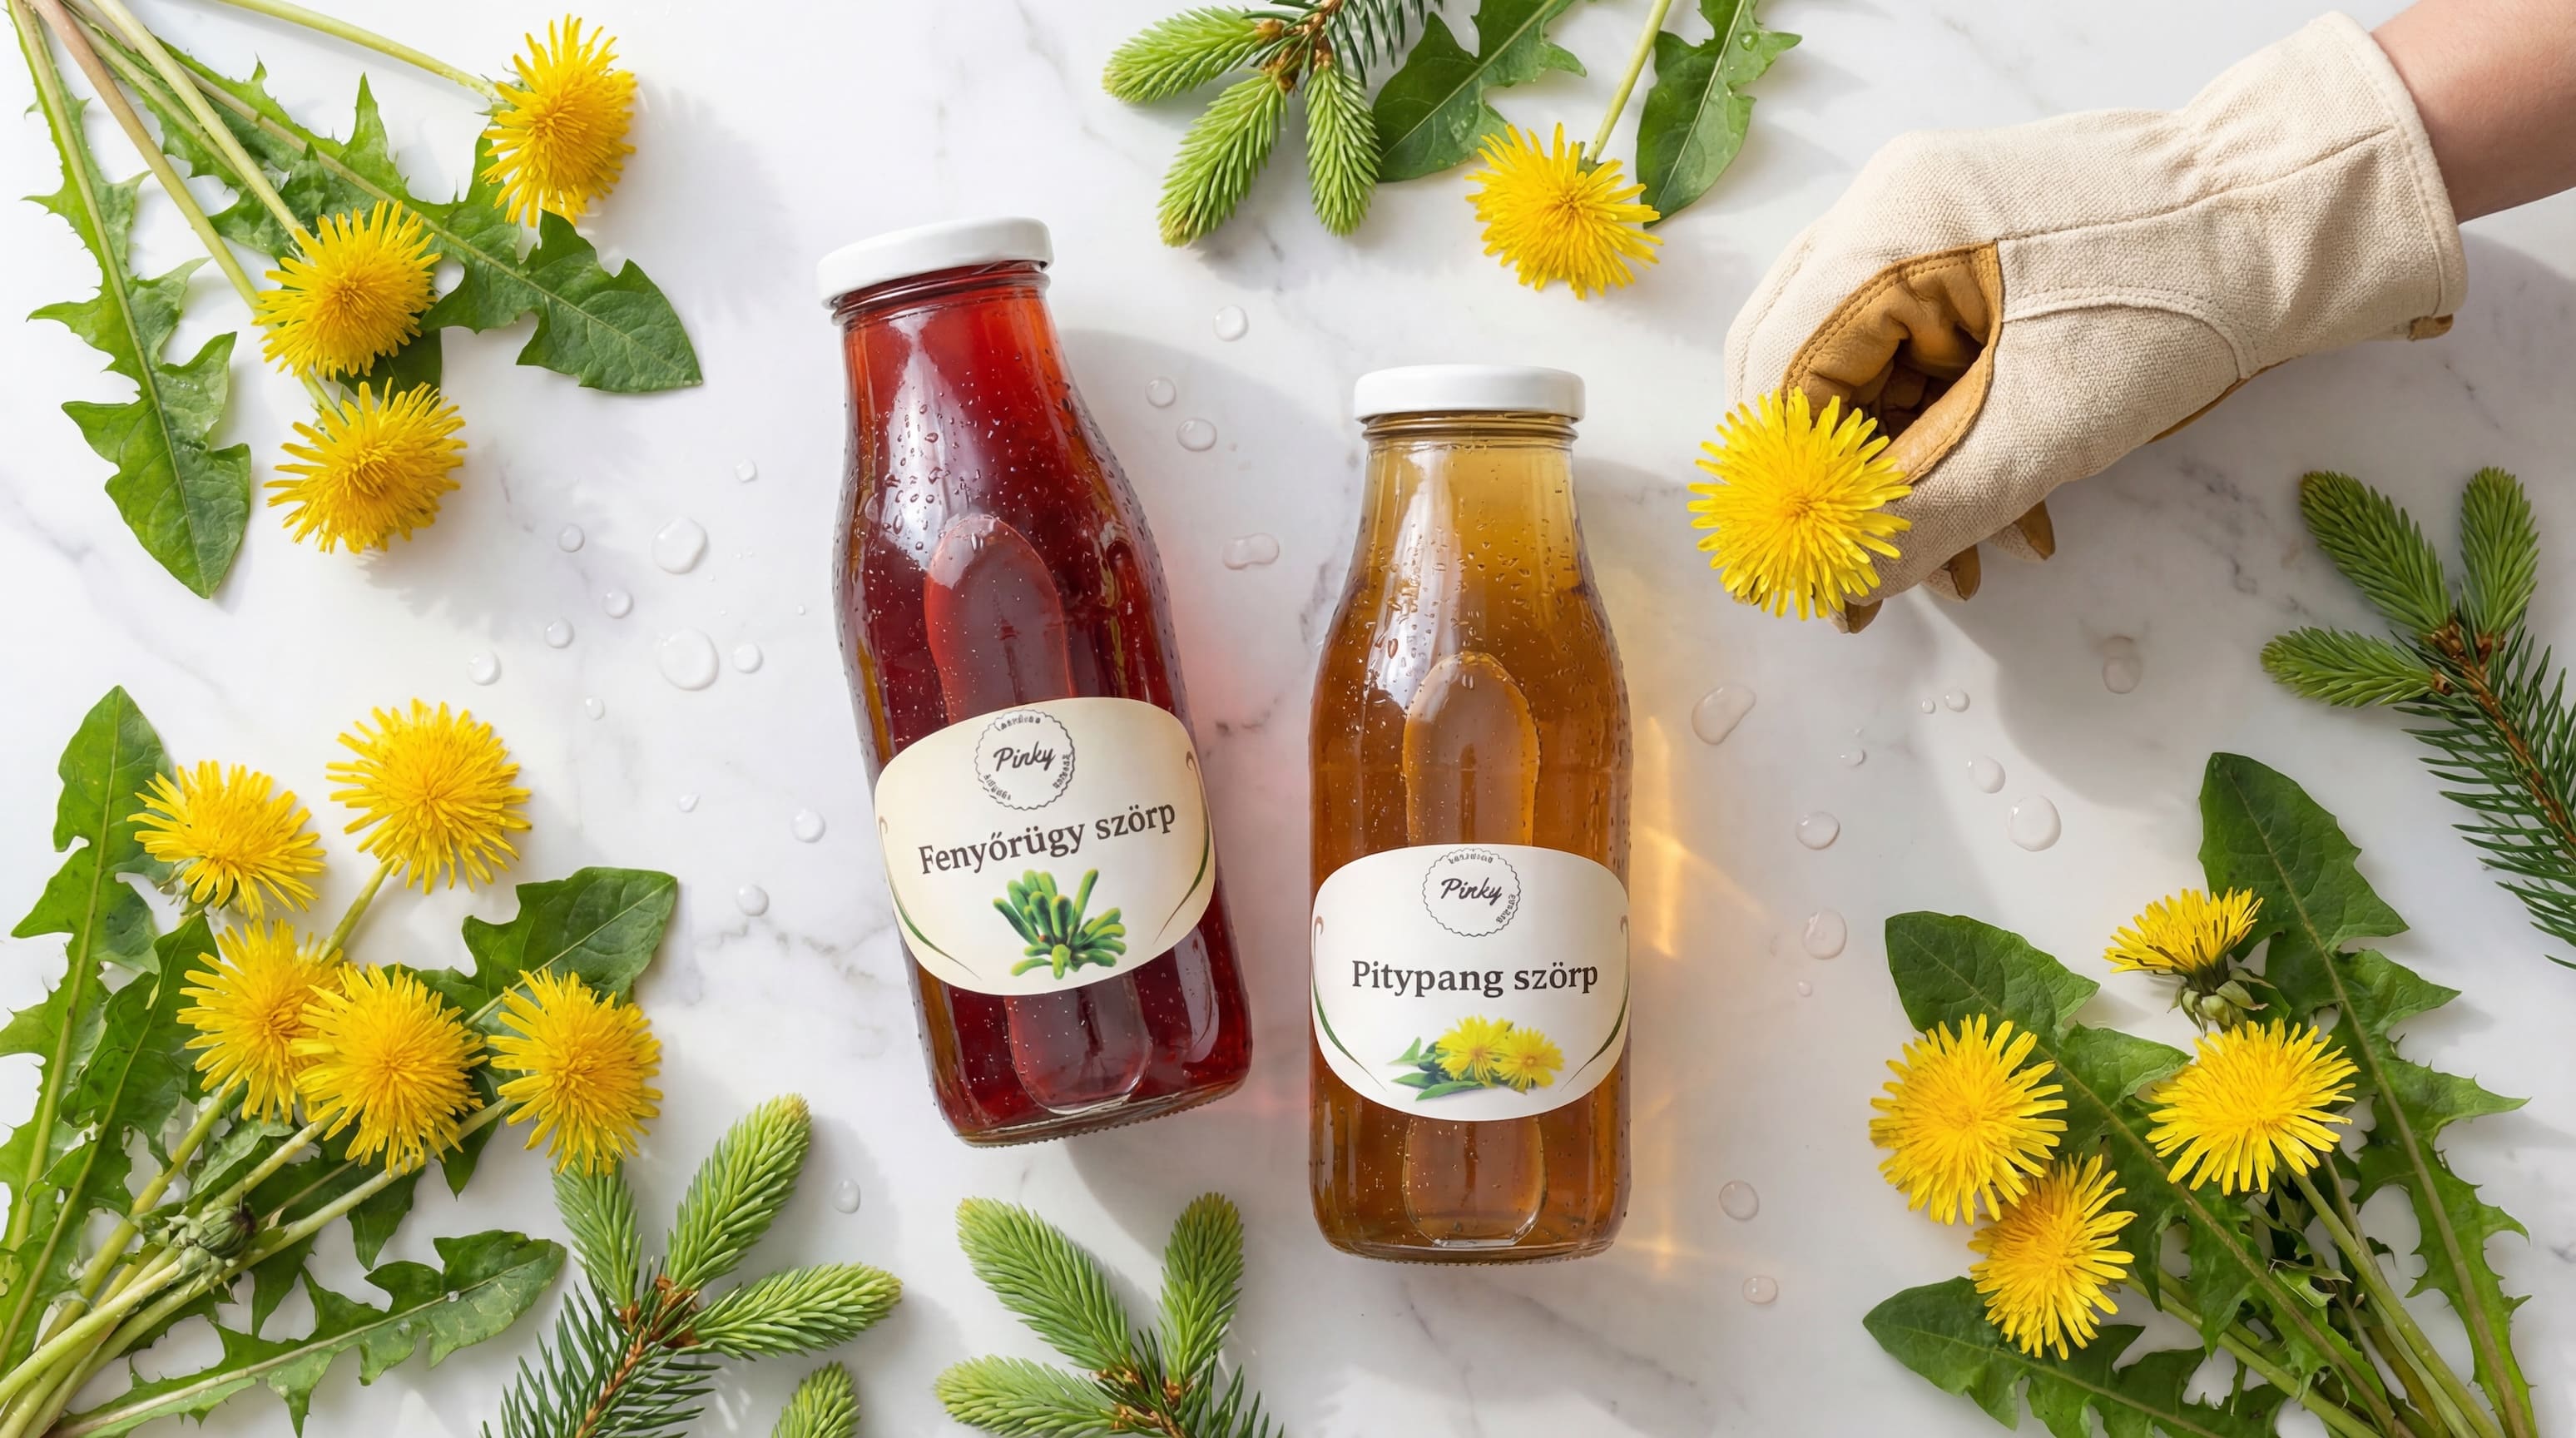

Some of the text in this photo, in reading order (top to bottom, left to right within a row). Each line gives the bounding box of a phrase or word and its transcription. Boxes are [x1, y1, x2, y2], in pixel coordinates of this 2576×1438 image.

[993, 741, 1056, 772] Pinky
[918, 803, 1176, 875] Fenyőrügy szörp
[1440, 876, 1503, 906] Pinky
[1352, 960, 1598, 999] Pitypang szörp
